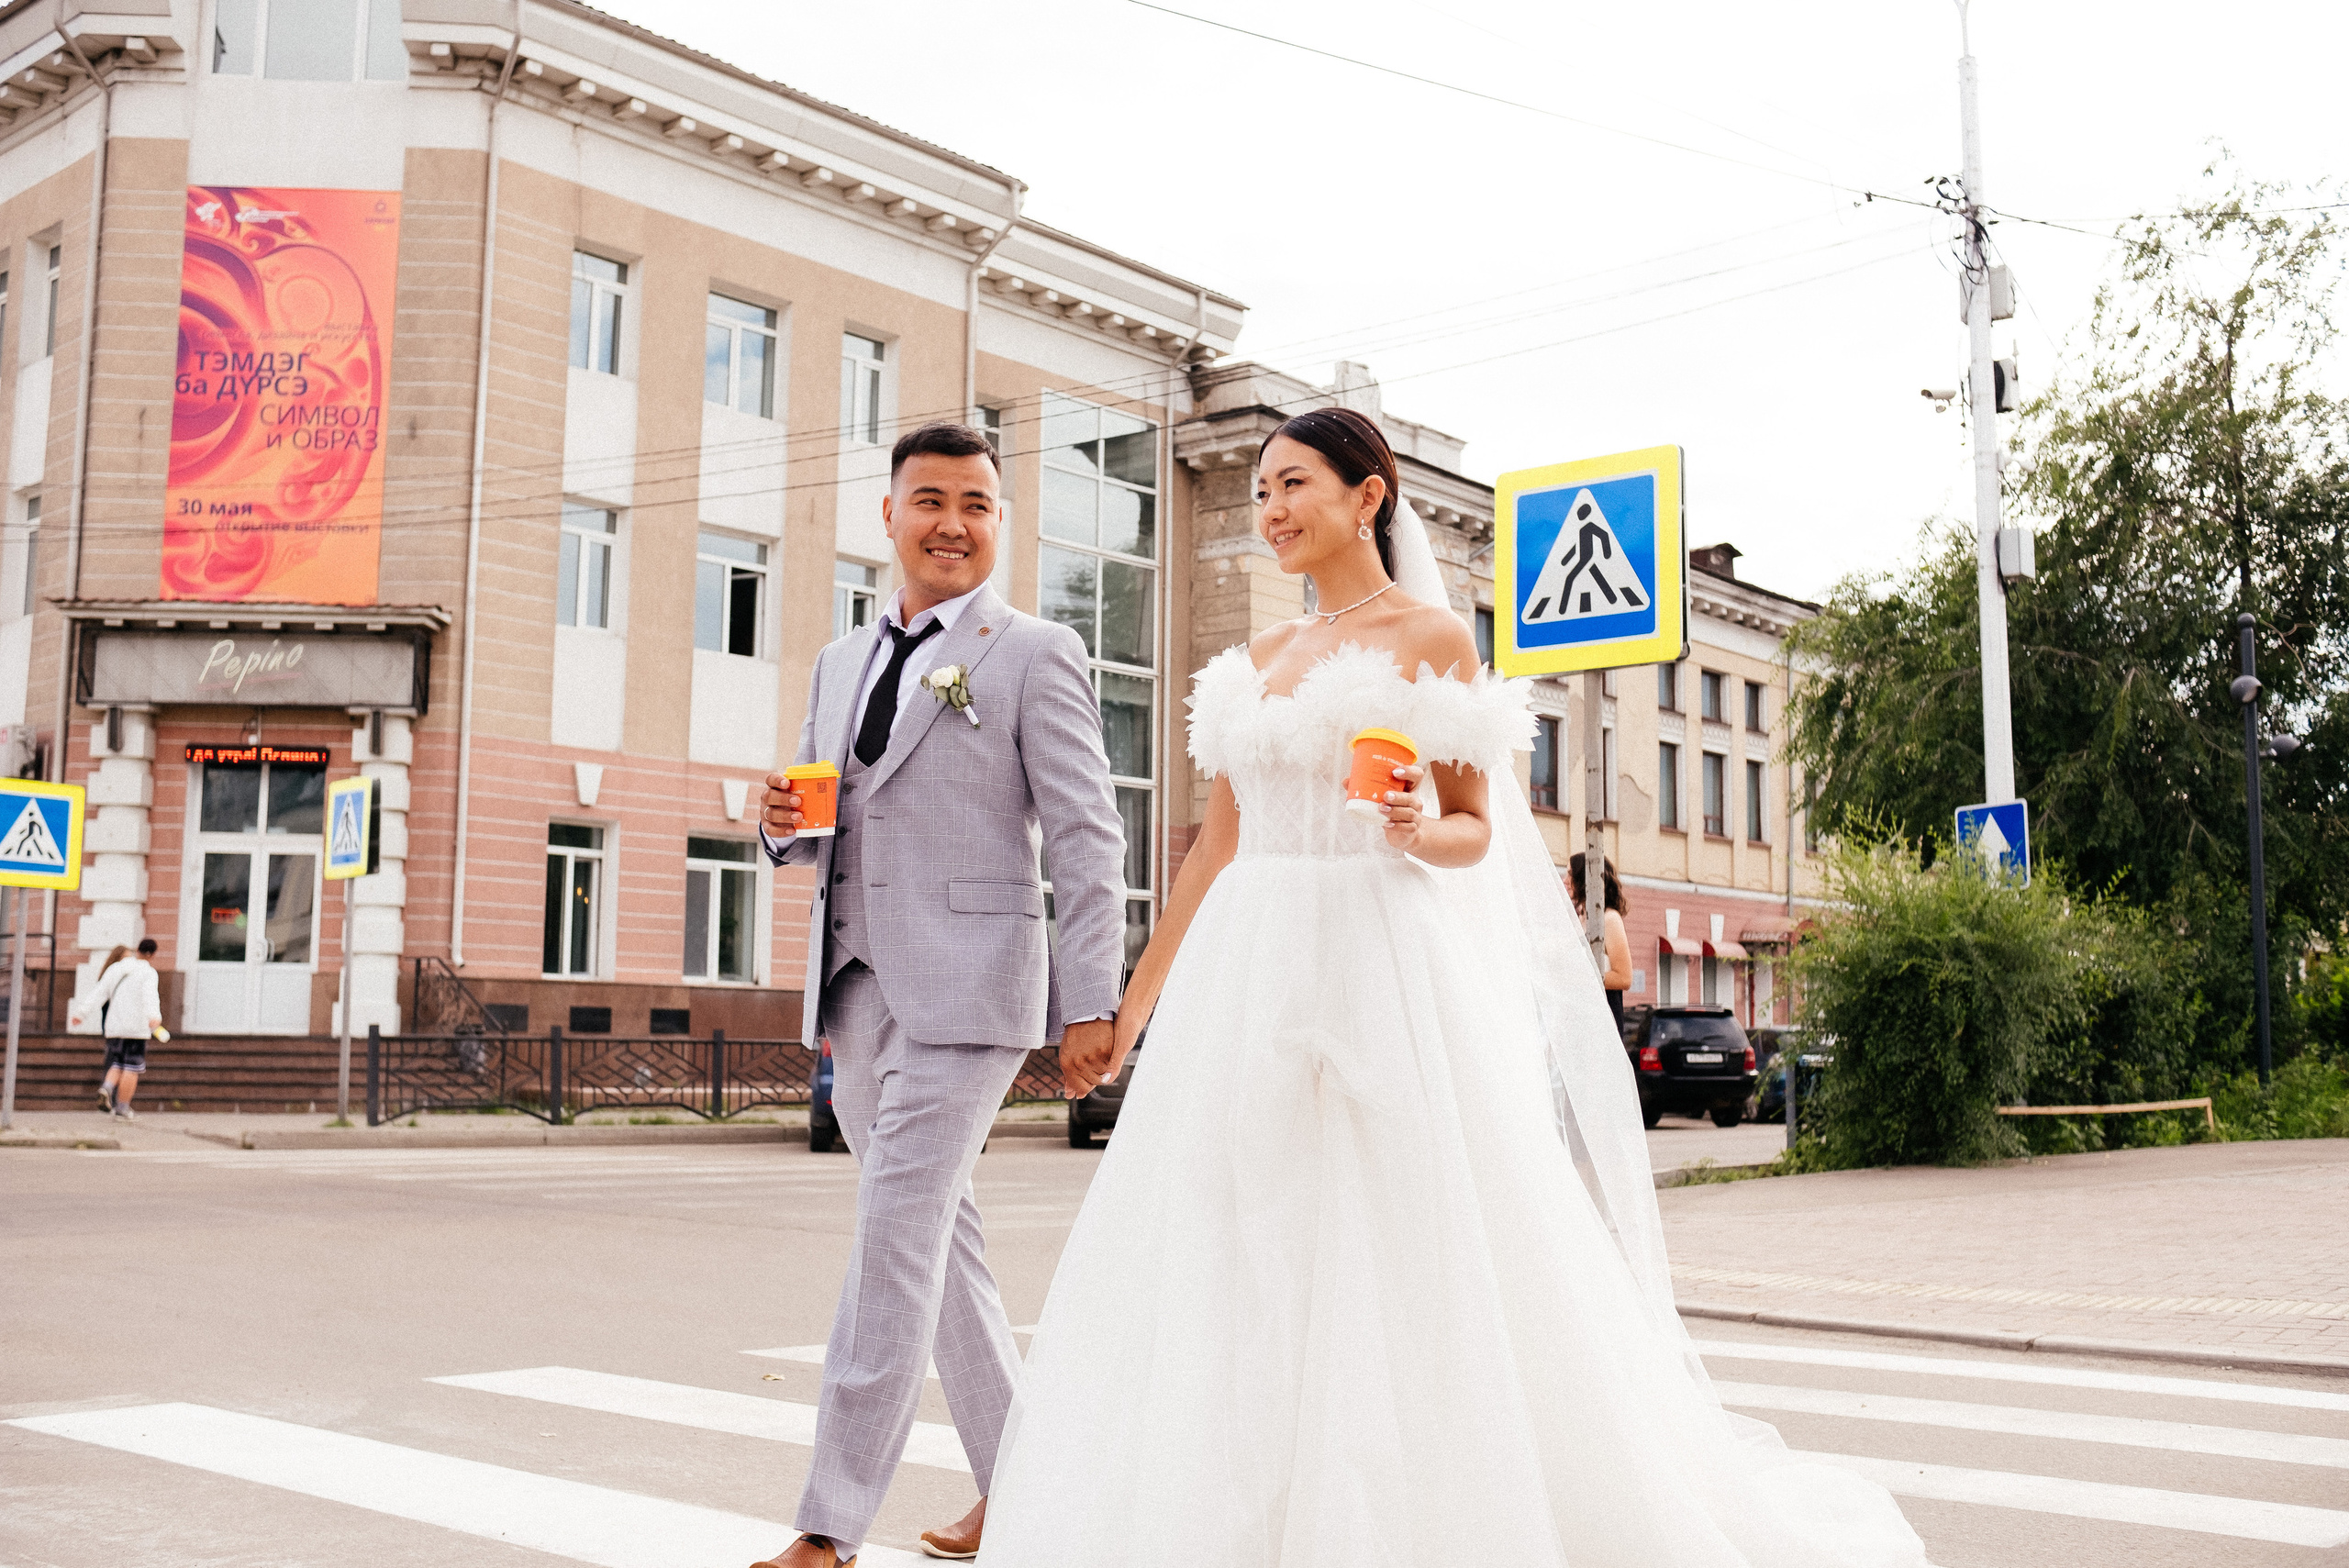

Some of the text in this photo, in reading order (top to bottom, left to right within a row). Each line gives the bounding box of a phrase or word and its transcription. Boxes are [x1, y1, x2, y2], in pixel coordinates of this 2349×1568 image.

[194, 350, 310, 377] ТЭМДЭГ
[174, 374, 207, 395] ба
[260, 404, 380, 429] СИМВОЛ
[266, 428, 378, 452] и ОБРАЗ
[176, 498, 252, 516] 30 мая
[197, 638, 305, 695] Pepino
